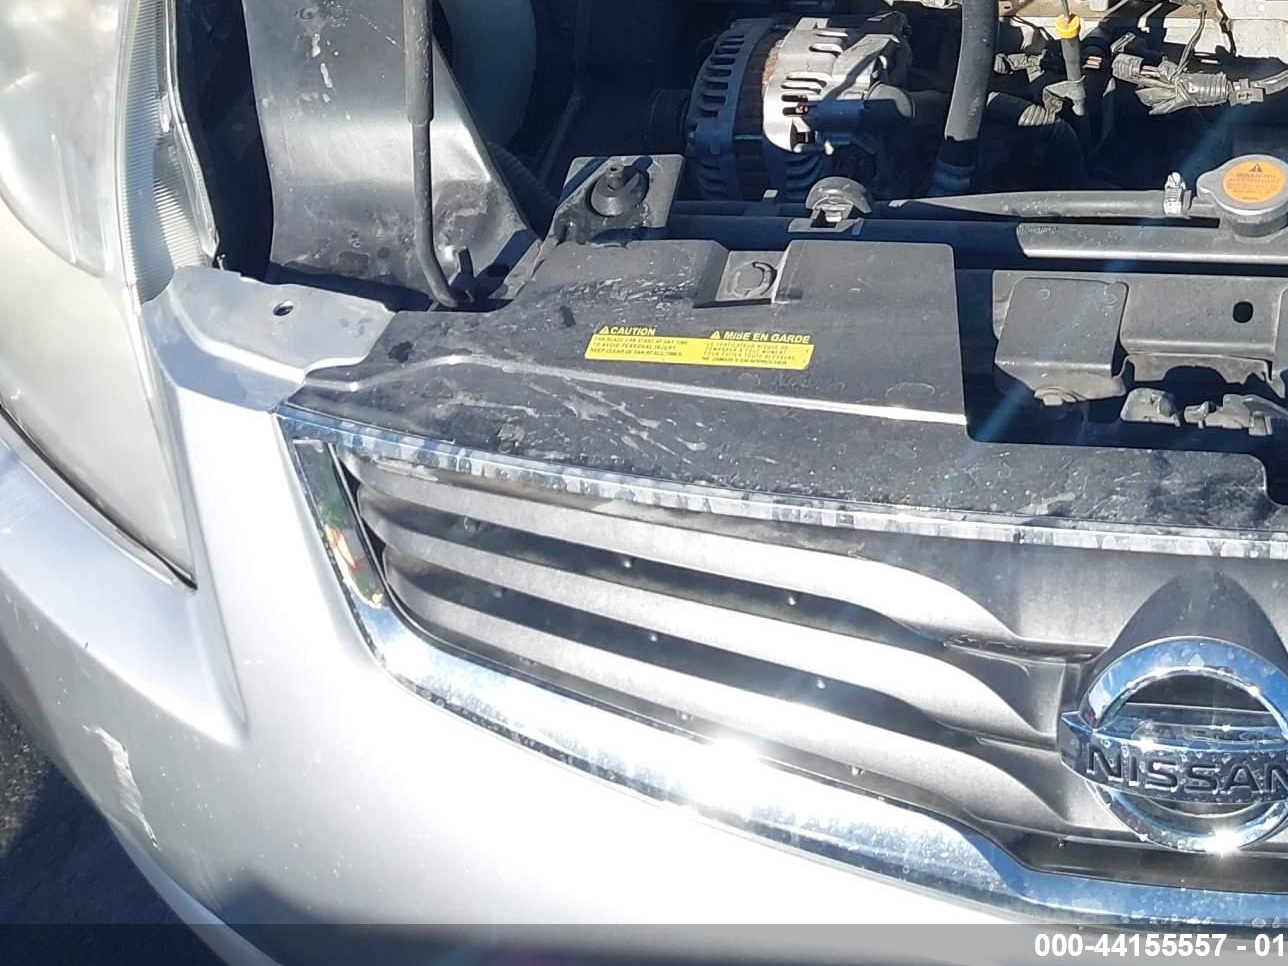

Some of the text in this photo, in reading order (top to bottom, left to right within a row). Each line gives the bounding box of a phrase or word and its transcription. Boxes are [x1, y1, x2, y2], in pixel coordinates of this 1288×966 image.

[610, 326, 656, 336] CAUTION
[723, 330, 811, 344] MISE EN GARDE
